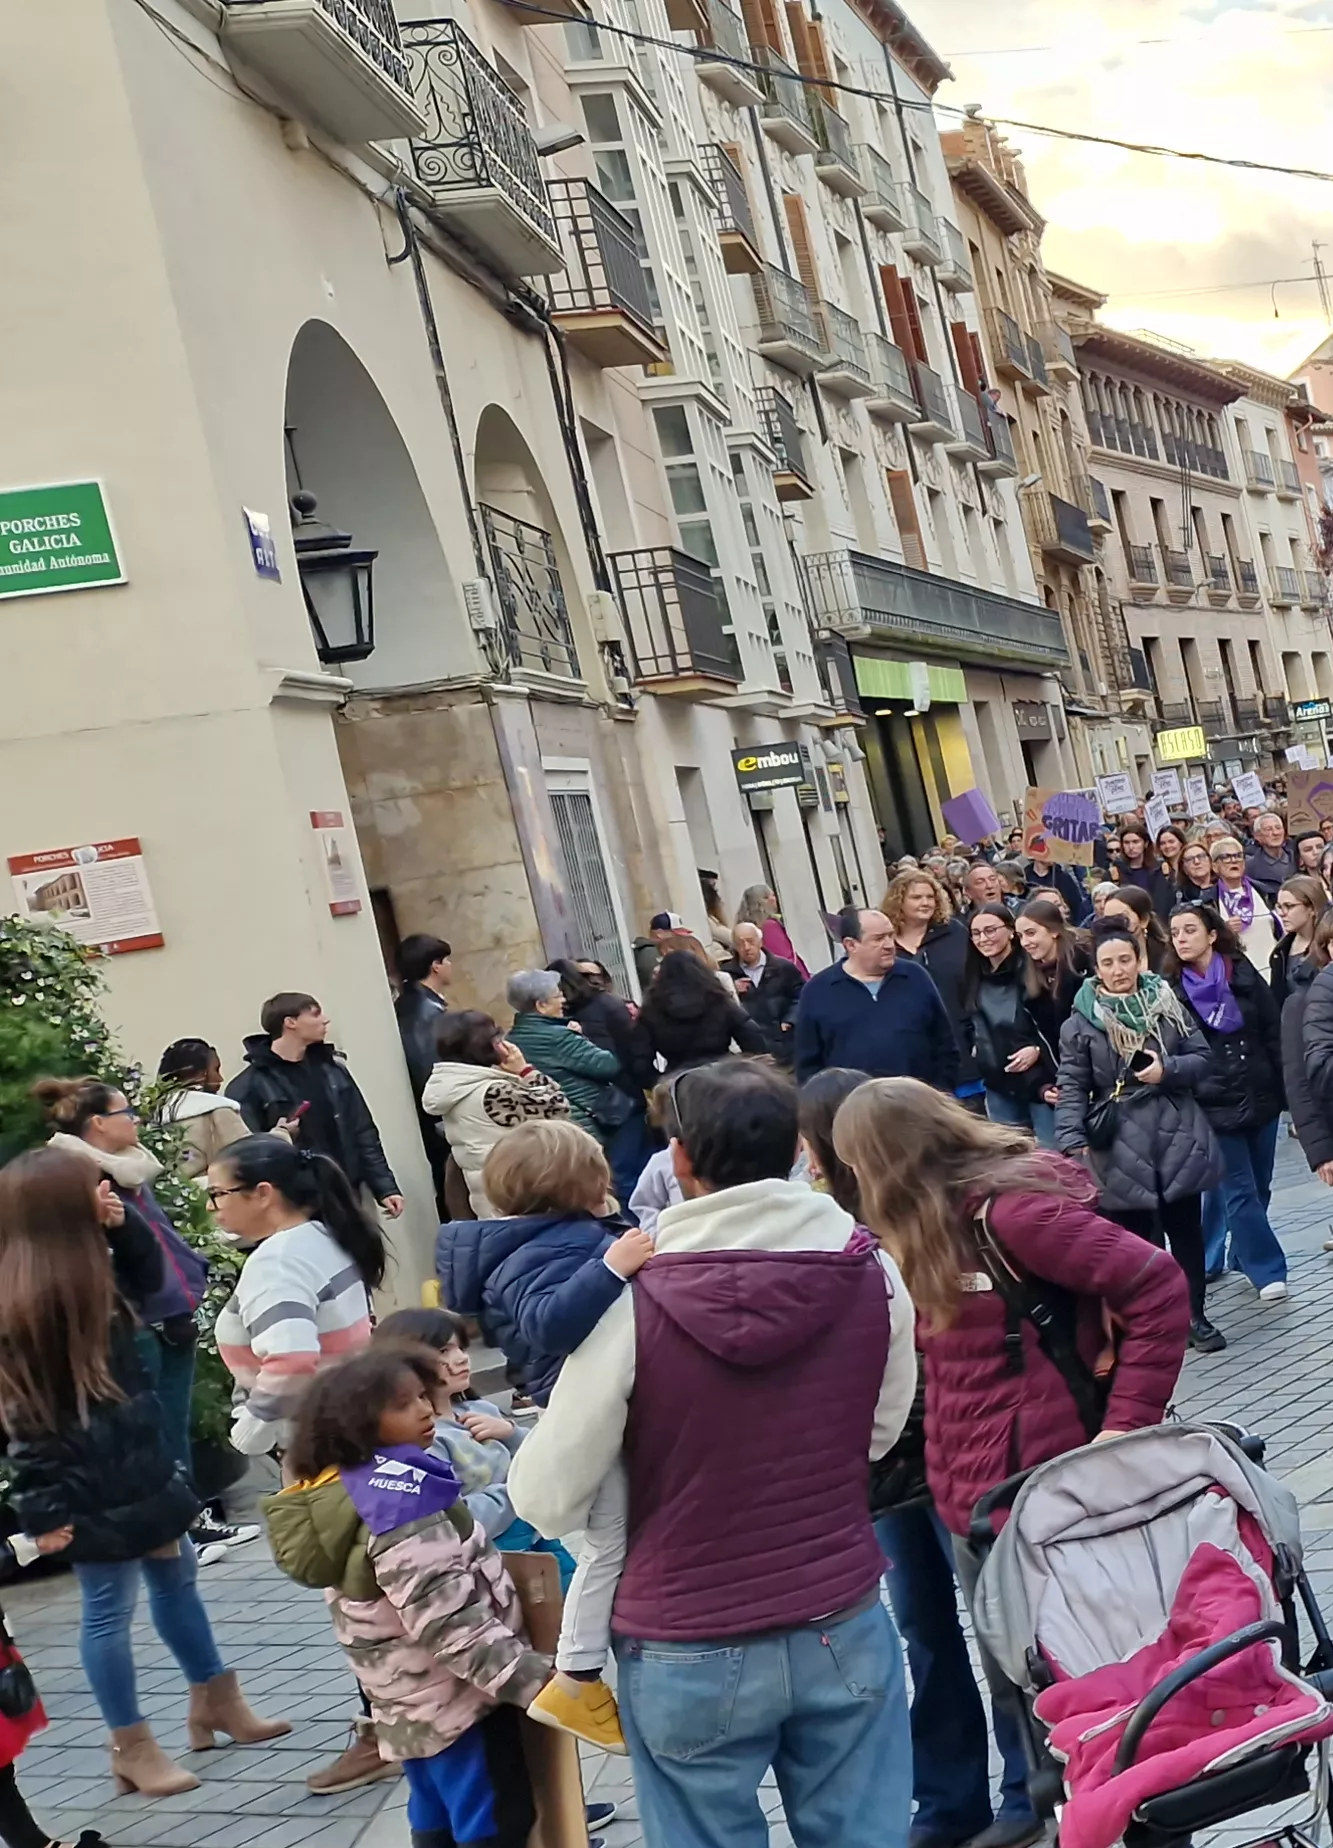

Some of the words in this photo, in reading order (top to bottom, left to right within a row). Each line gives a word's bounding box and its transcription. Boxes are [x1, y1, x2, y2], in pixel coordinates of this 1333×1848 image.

[0, 512, 81, 536] PORCHES
[9, 532, 82, 554] GALICIA
[49, 552, 111, 569] Autónoma
[1160, 728, 1202, 755] ASCASO
[737, 751, 799, 771] embou
[368, 1477, 421, 1495] HUESCA
